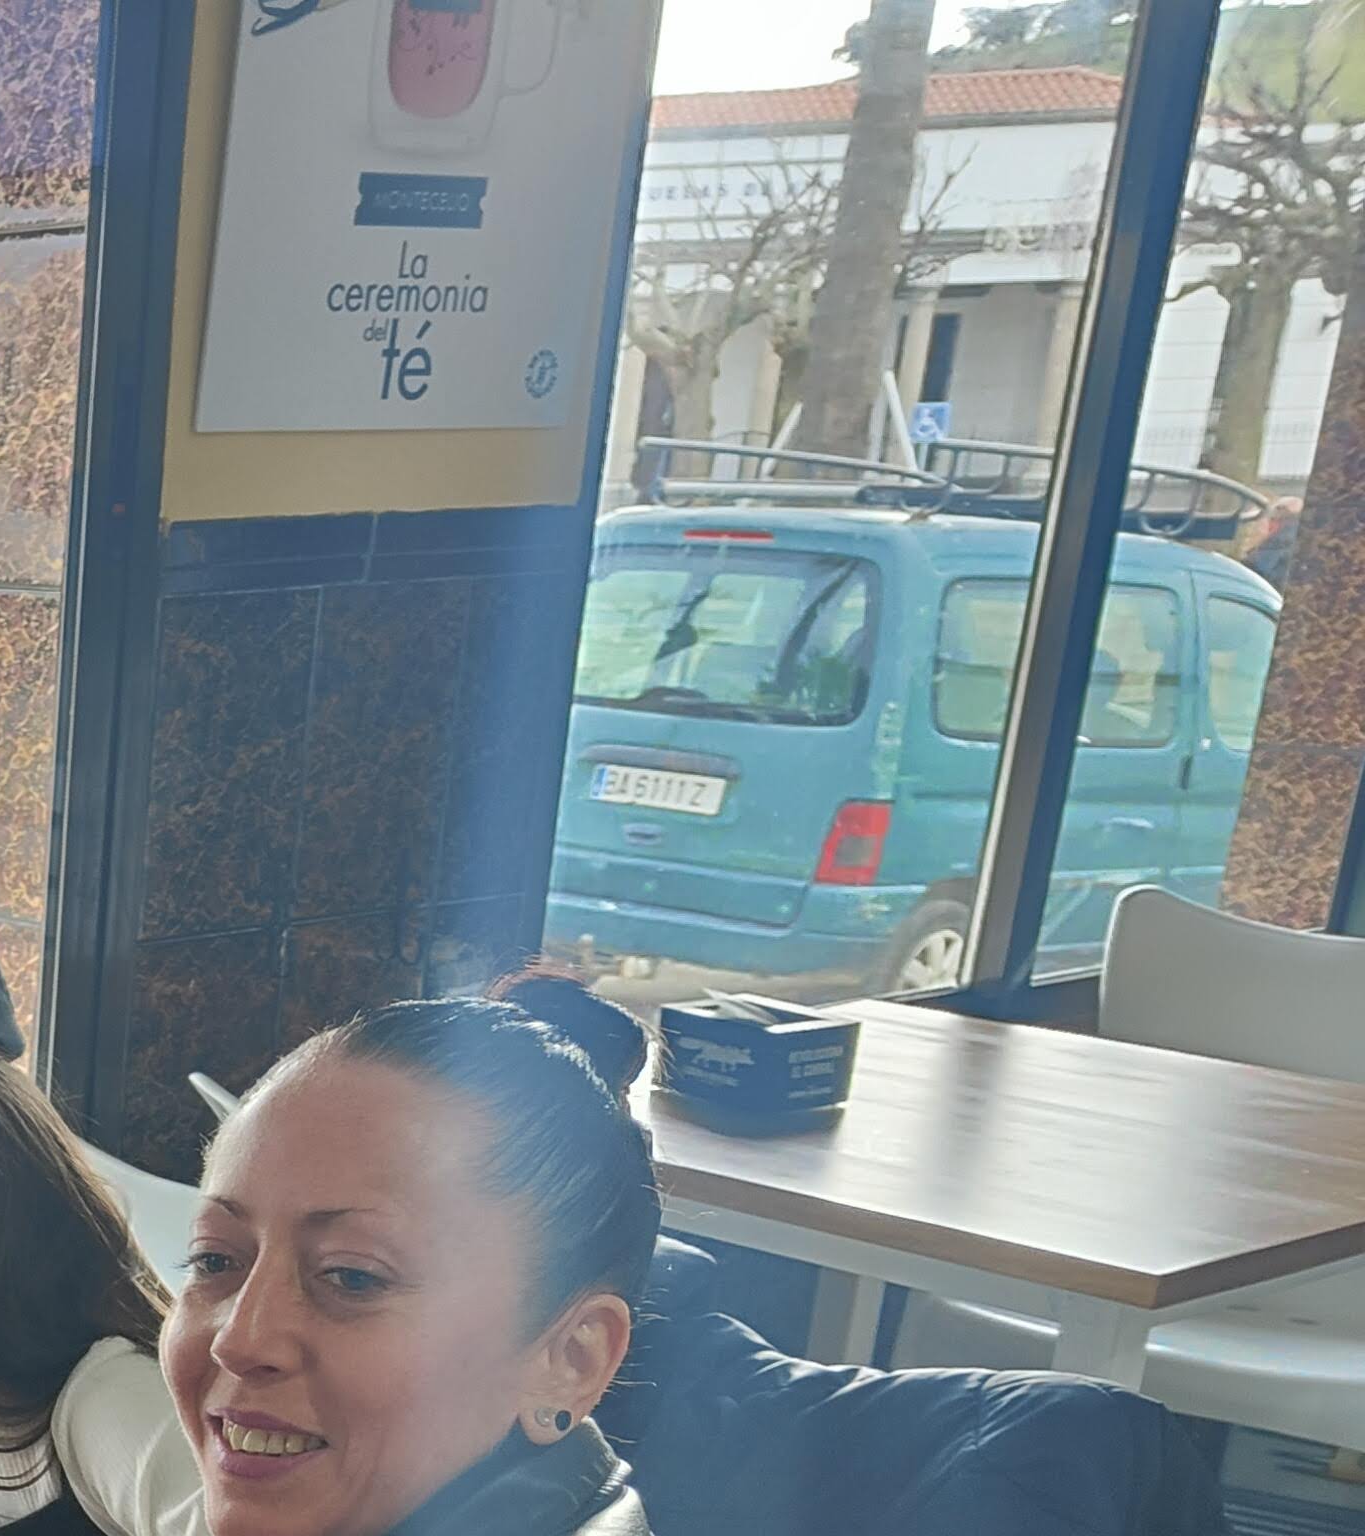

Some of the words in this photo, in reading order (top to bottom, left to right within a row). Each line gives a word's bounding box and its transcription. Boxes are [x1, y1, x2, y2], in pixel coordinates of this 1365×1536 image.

[397, 240, 429, 280] La
[326, 273, 488, 313] ceremonia
[362, 318, 390, 342] del
[380, 317, 433, 401] té
